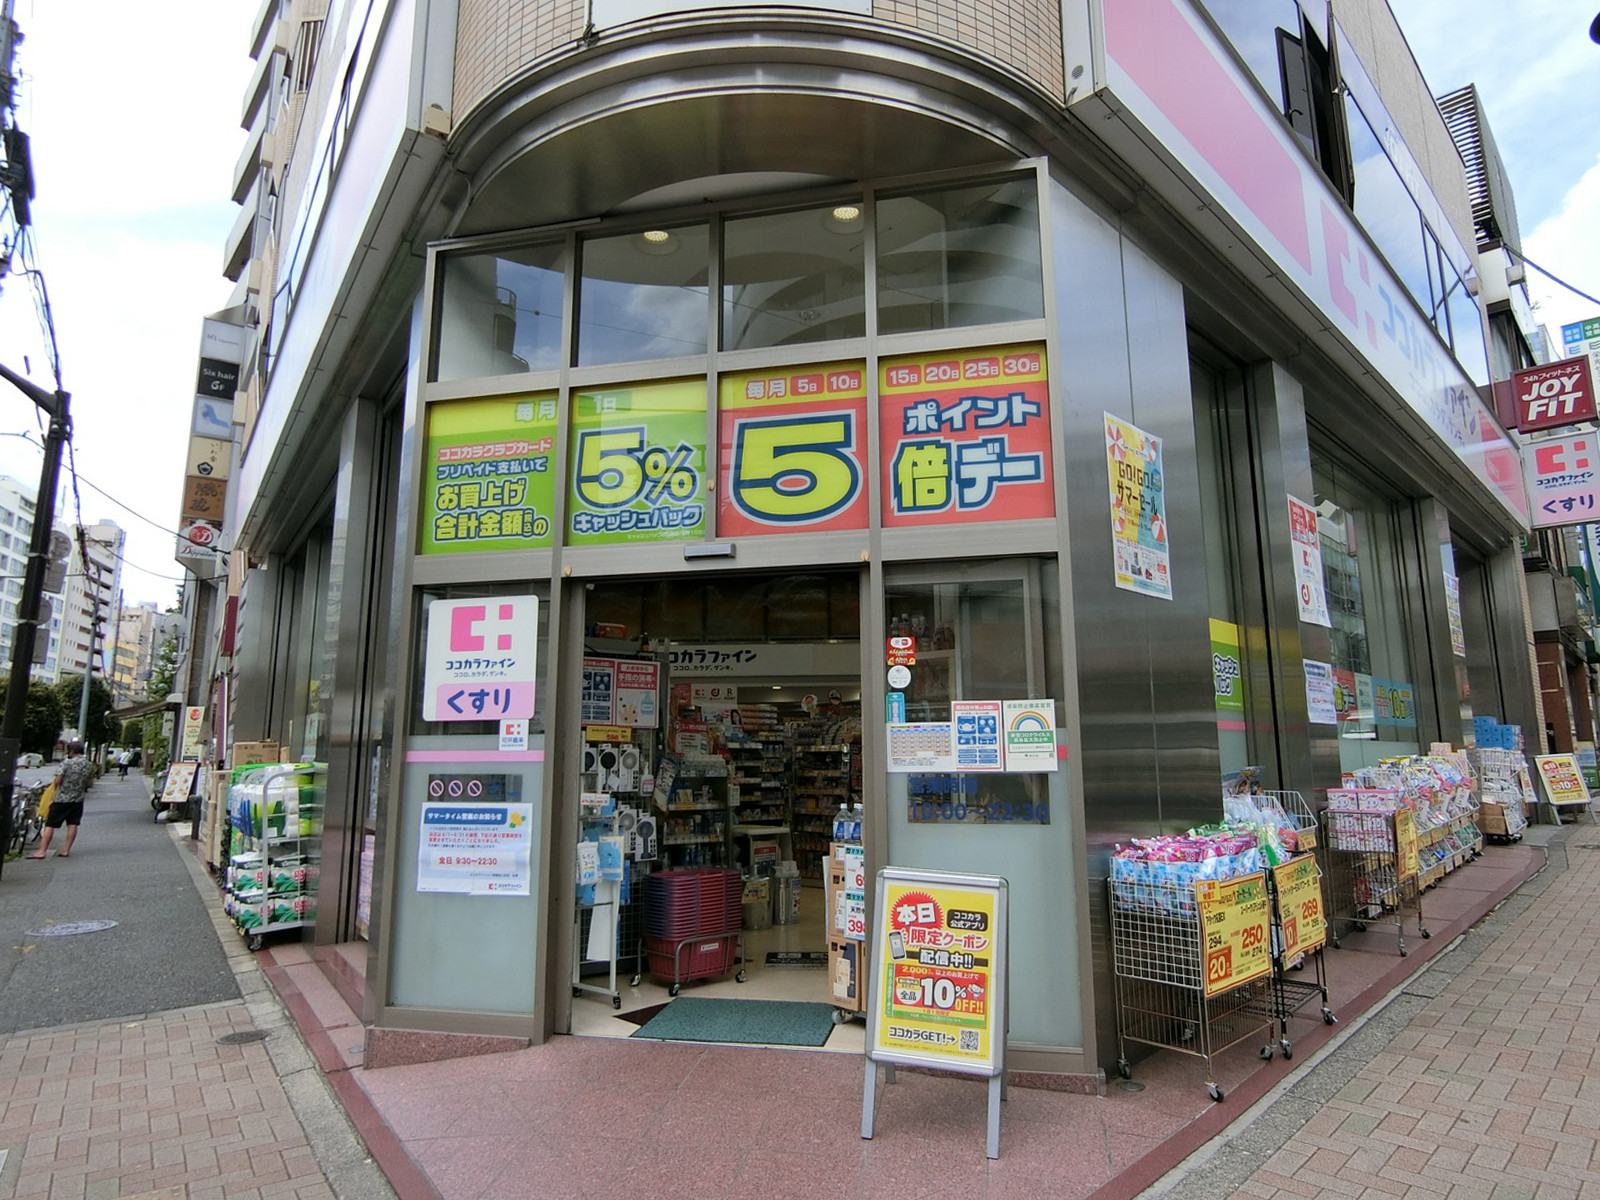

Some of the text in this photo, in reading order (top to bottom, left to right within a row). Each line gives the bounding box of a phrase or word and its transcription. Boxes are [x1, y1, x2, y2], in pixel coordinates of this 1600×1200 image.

[890, 356, 1039, 384] 15日 20日 25日 30日
[747, 373, 857, 398] 毎月 5日 10日
[1521, 373, 1582, 401] JOY
[516, 400, 556, 421] 毎月
[904, 393, 1040, 434] ポイント
[1528, 391, 1583, 421] FIT
[438, 438, 552, 462] ココカラクラブカード
[575, 424, 699, 509] 5%
[731, 411, 862, 525] 5
[892, 435, 1044, 514] 倍デー
[1536, 471, 1594, 486] ココカラファイン
[437, 478, 526, 512] お買上げ
[1116, 480, 1158, 515] サマーセール
[1542, 493, 1594, 514] くすり
[573, 504, 704, 535] キャッシュバック
[446, 658, 516, 670] ココカラファイン
[447, 688, 511, 714] くすり
[438, 857, 453, 865] 全日
[896, 903, 935, 926] 本日
[953, 911, 982, 922] ココカラ
[1301, 897, 1318, 920] 269
[950, 919, 985, 930] 公式アプリ
[1241, 923, 1263, 949] 250
[910, 927, 988, 950] 限定クーポン
[919, 949, 973, 969] 配信中!!
[1209, 956, 1227, 980] 20
[900, 990, 917, 1001] 全品
[954, 998, 985, 1014] OFF!!
[889, 1026, 947, 1043] ココカラGET!
